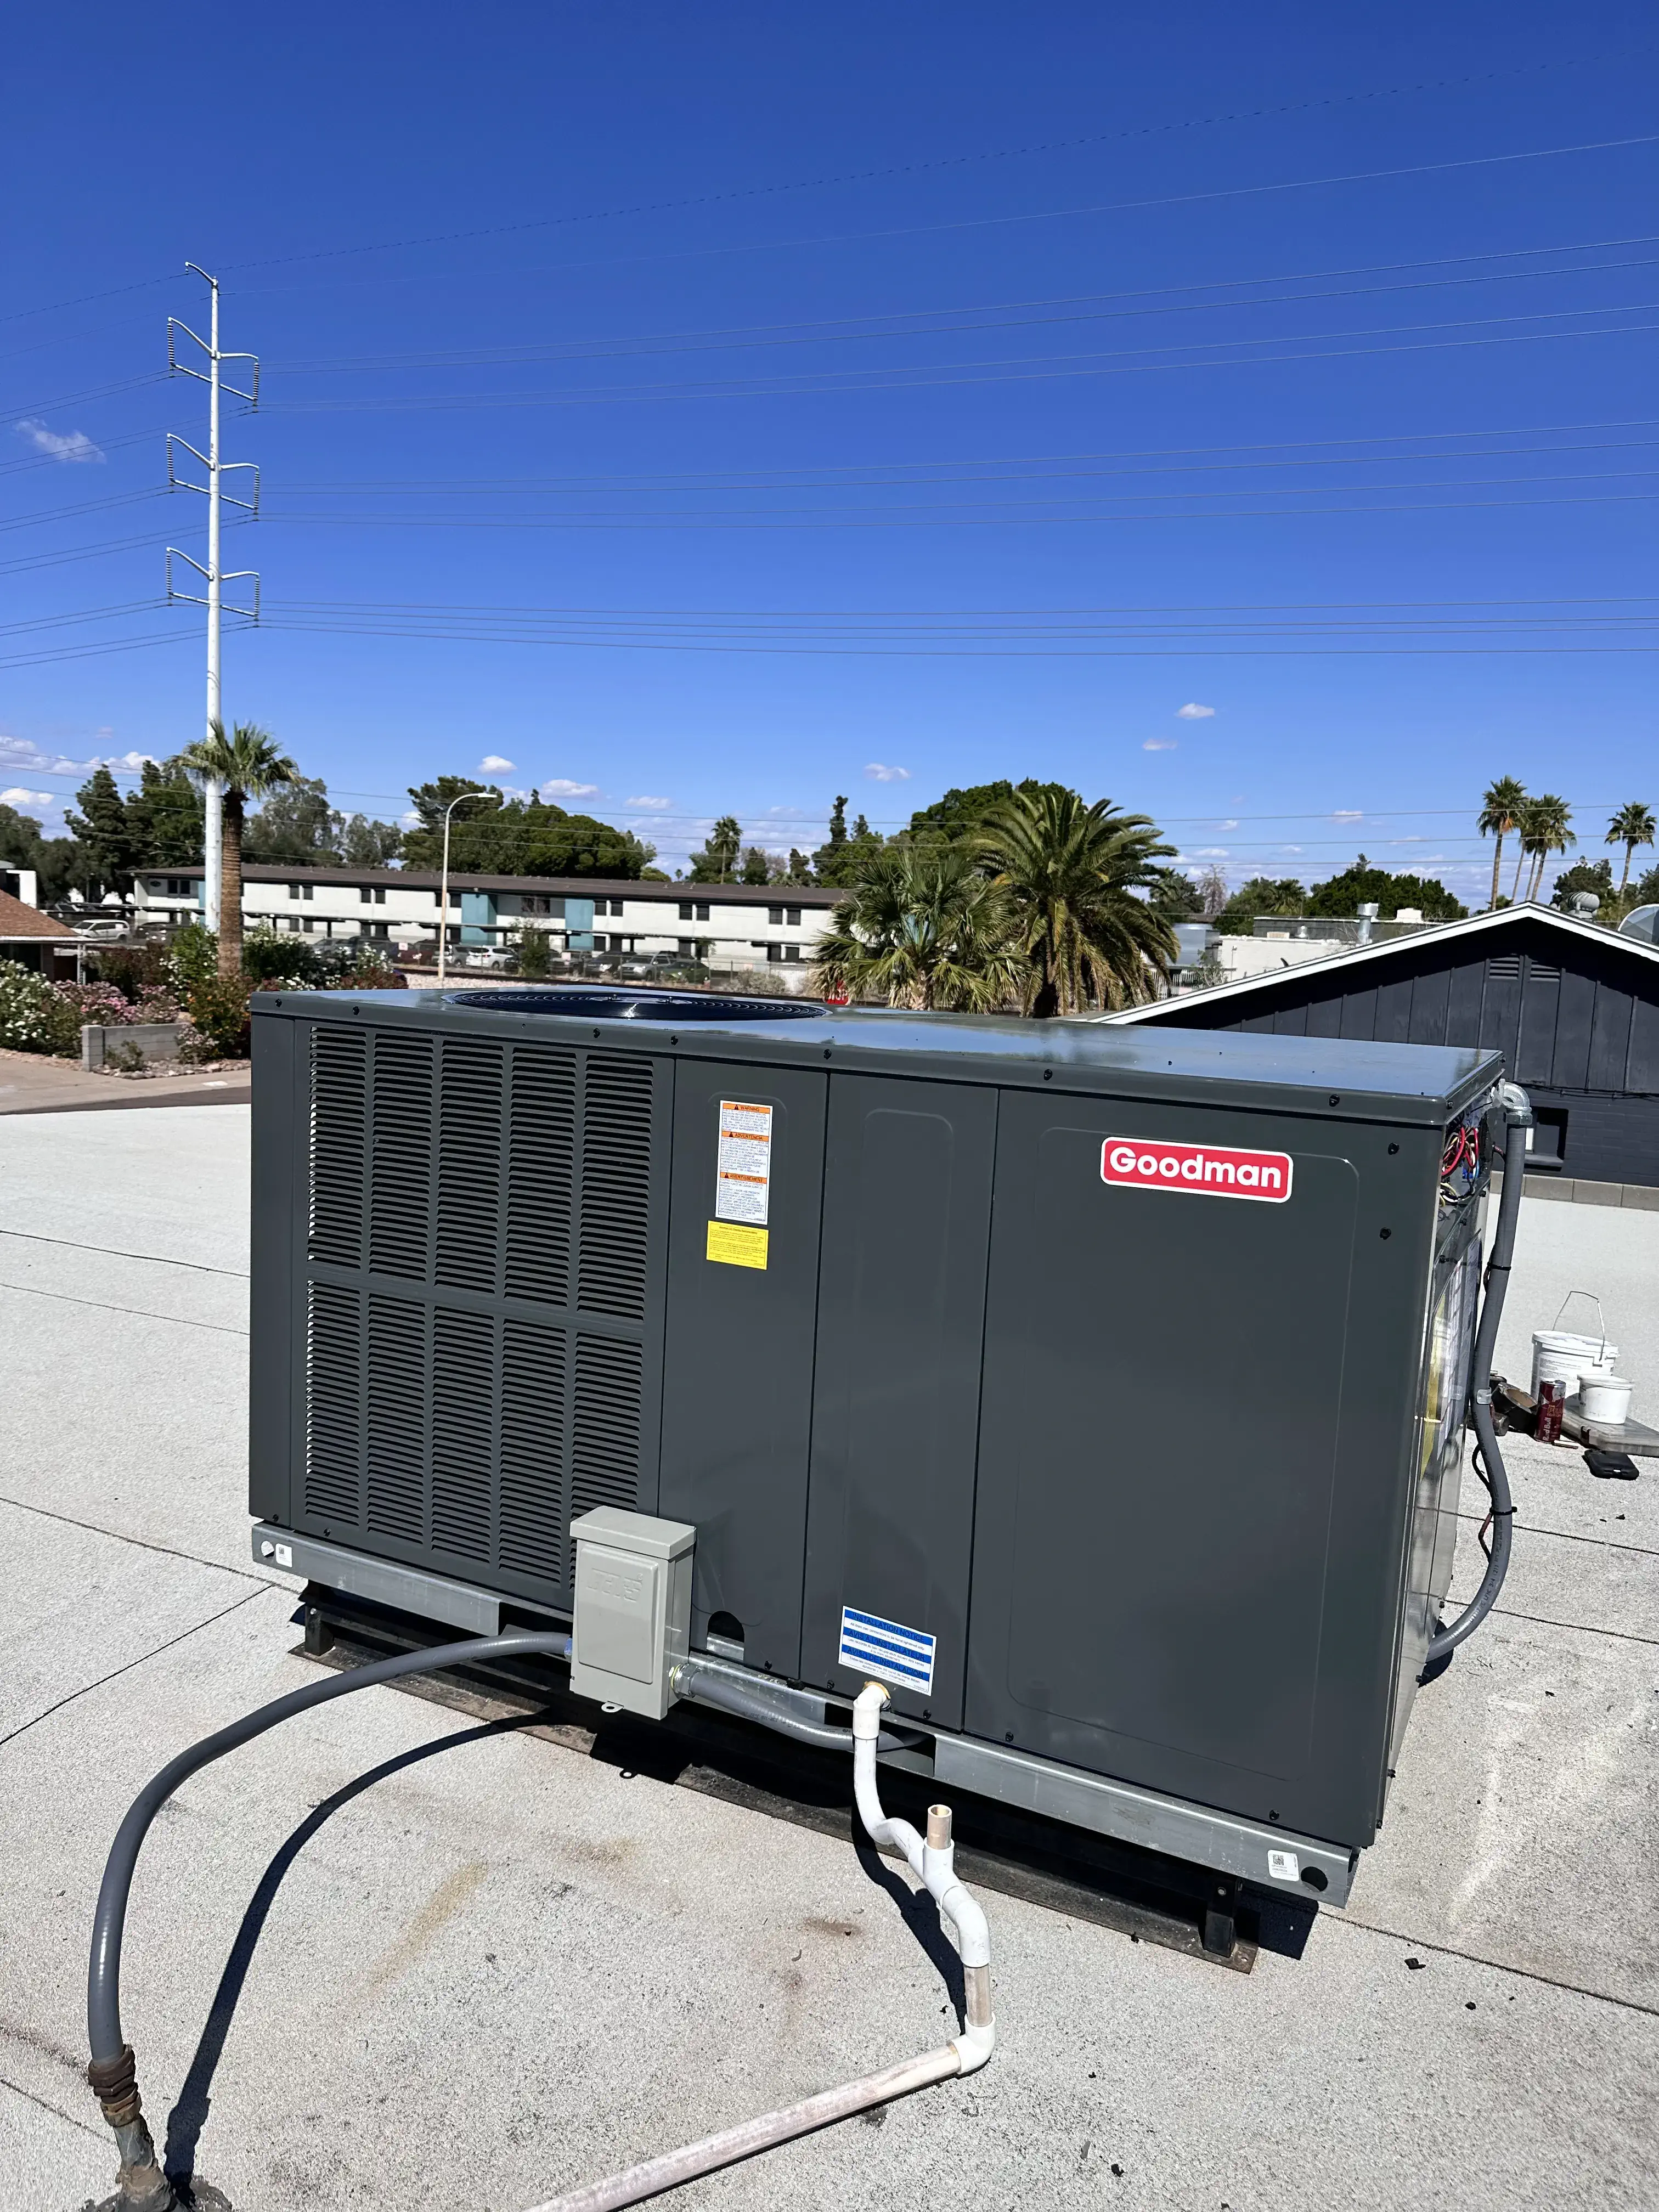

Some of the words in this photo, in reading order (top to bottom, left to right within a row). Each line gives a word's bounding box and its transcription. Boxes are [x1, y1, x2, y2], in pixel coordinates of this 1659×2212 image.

[1110, 1147, 1281, 1189] Goodman
[849, 1629, 862, 1639] AVIS
[853, 1613, 898, 1633] INSTALLATION
[900, 1629, 924, 1643] NOTICE
[848, 1647, 867, 1658] AVISO
